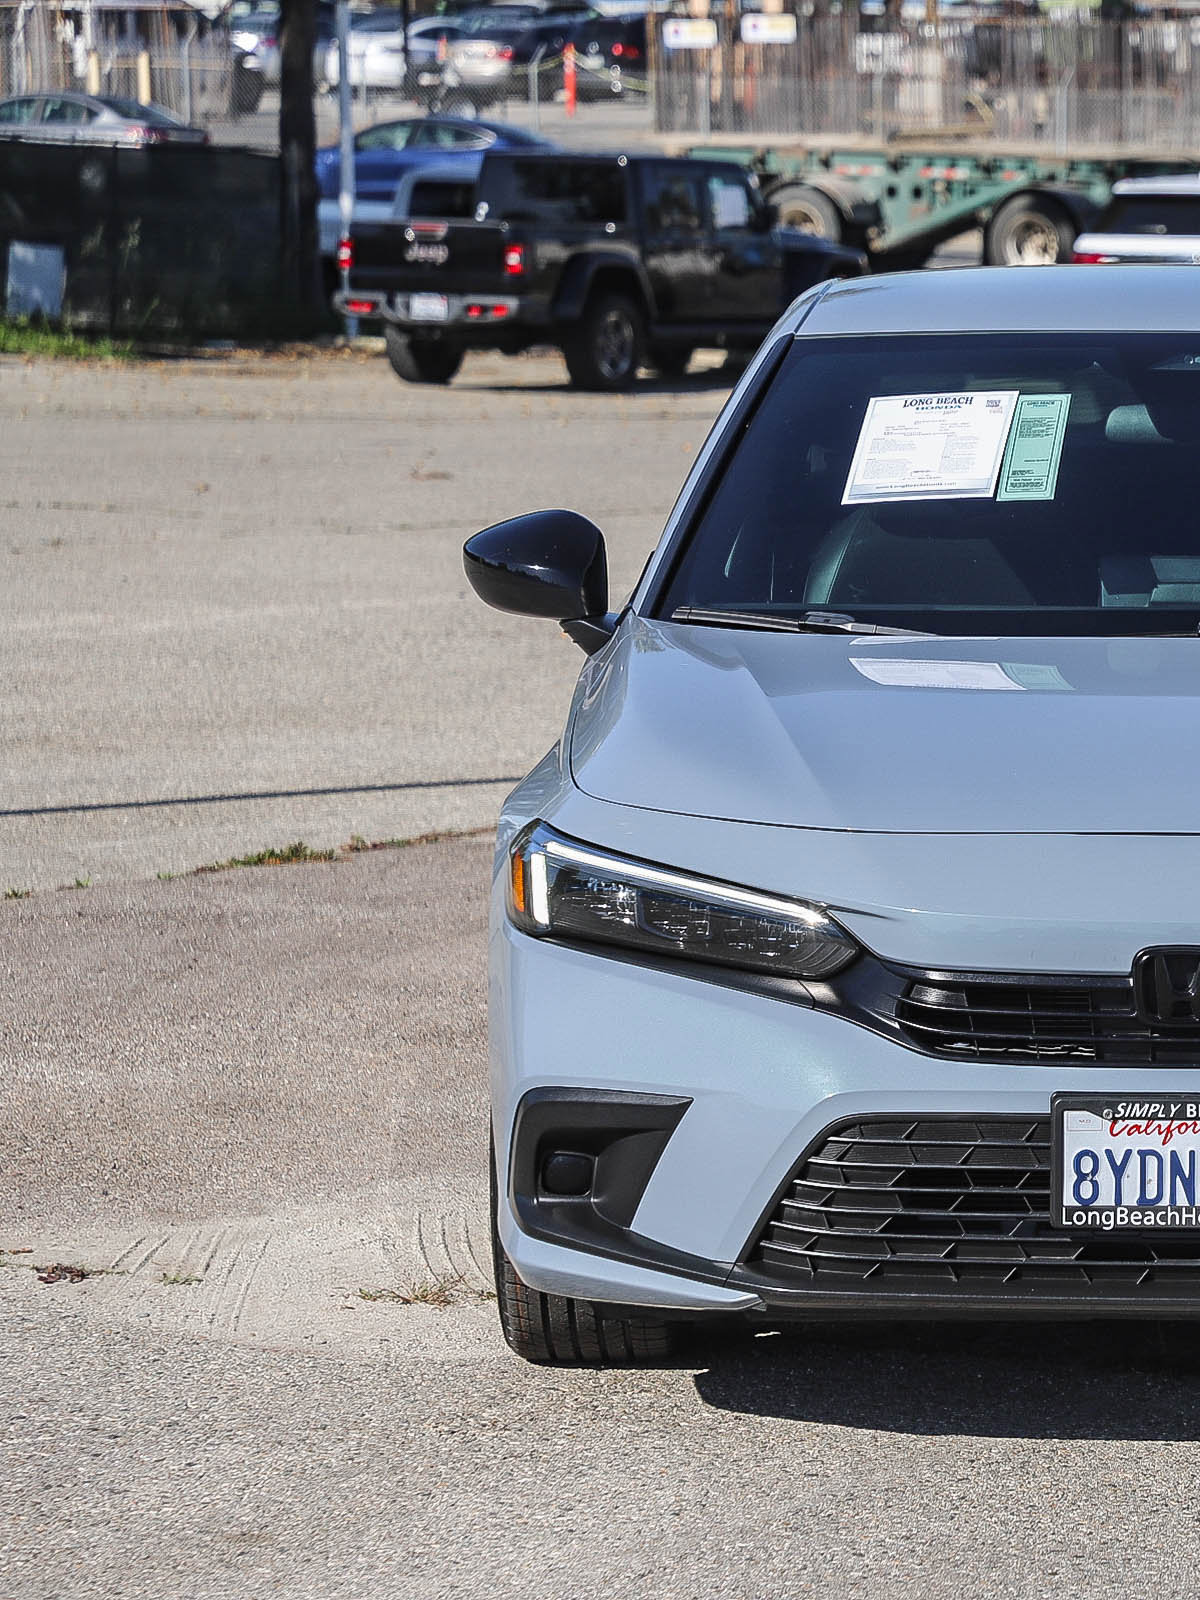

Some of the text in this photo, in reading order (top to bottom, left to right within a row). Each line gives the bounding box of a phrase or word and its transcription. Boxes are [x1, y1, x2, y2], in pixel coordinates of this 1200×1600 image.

[903, 396, 974, 408] LONG BEACH
[1114, 1102, 1182, 1119] SIMPLY
